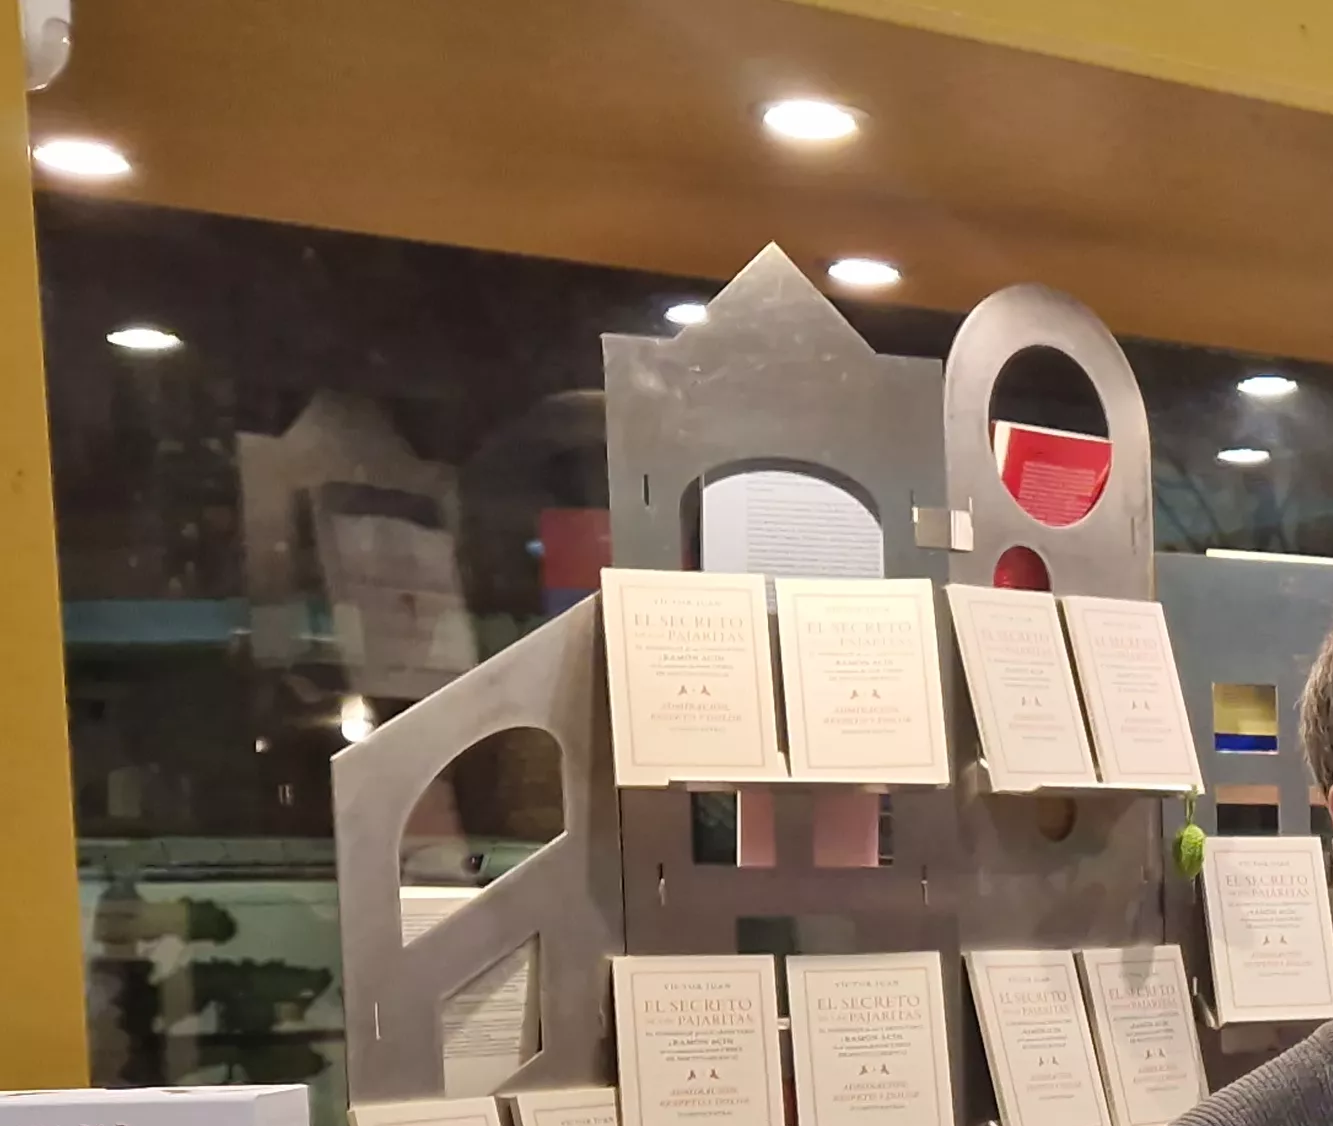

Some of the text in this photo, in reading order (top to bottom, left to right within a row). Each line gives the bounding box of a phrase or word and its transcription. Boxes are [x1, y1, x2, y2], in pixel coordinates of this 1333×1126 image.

[1225, 874, 1309, 887] EL SECRETO
[644, 998, 753, 1013] EL SECRETO
[817, 994, 921, 1011] EL SECRETO
[677, 1013, 755, 1027] PAJARITAS
[848, 1010, 923, 1024] PAJARITAS
